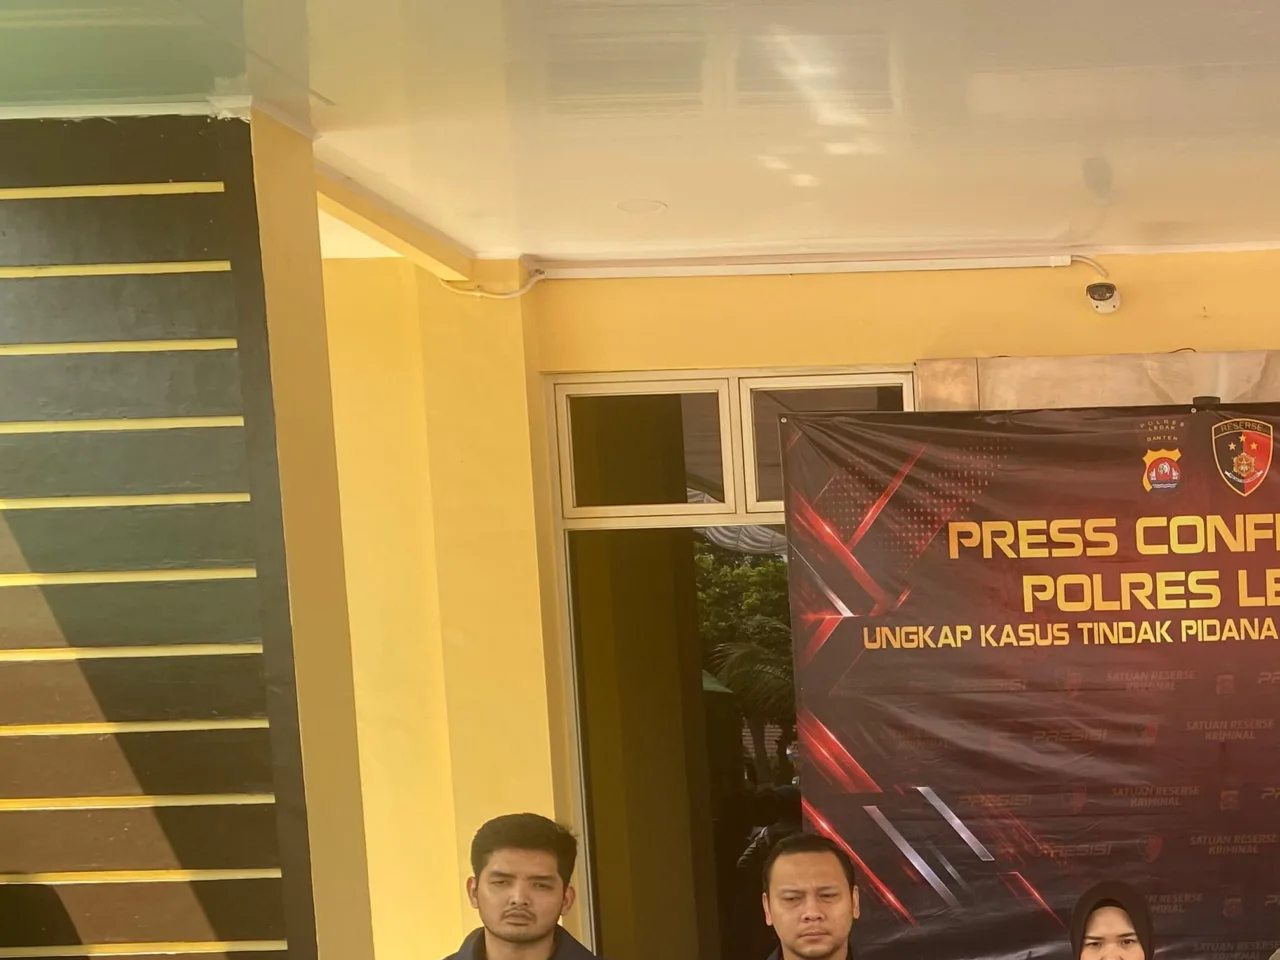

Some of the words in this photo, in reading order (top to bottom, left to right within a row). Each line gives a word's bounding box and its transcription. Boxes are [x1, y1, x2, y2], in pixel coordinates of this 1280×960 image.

[1221, 422, 1263, 432] RESERSE
[948, 517, 1118, 560] PRESS
[1023, 569, 1221, 613] POLRES
[863, 625, 973, 650] UNGKAP
[979, 622, 1070, 648] KASUS
[1078, 619, 1174, 645] TINDAK
[1180, 616, 1278, 642] PIDANA
[1186, 720, 1228, 731] SATUAN
[1112, 787, 1153, 798] SATUAN
[1190, 834, 1232, 846] SATUAN
